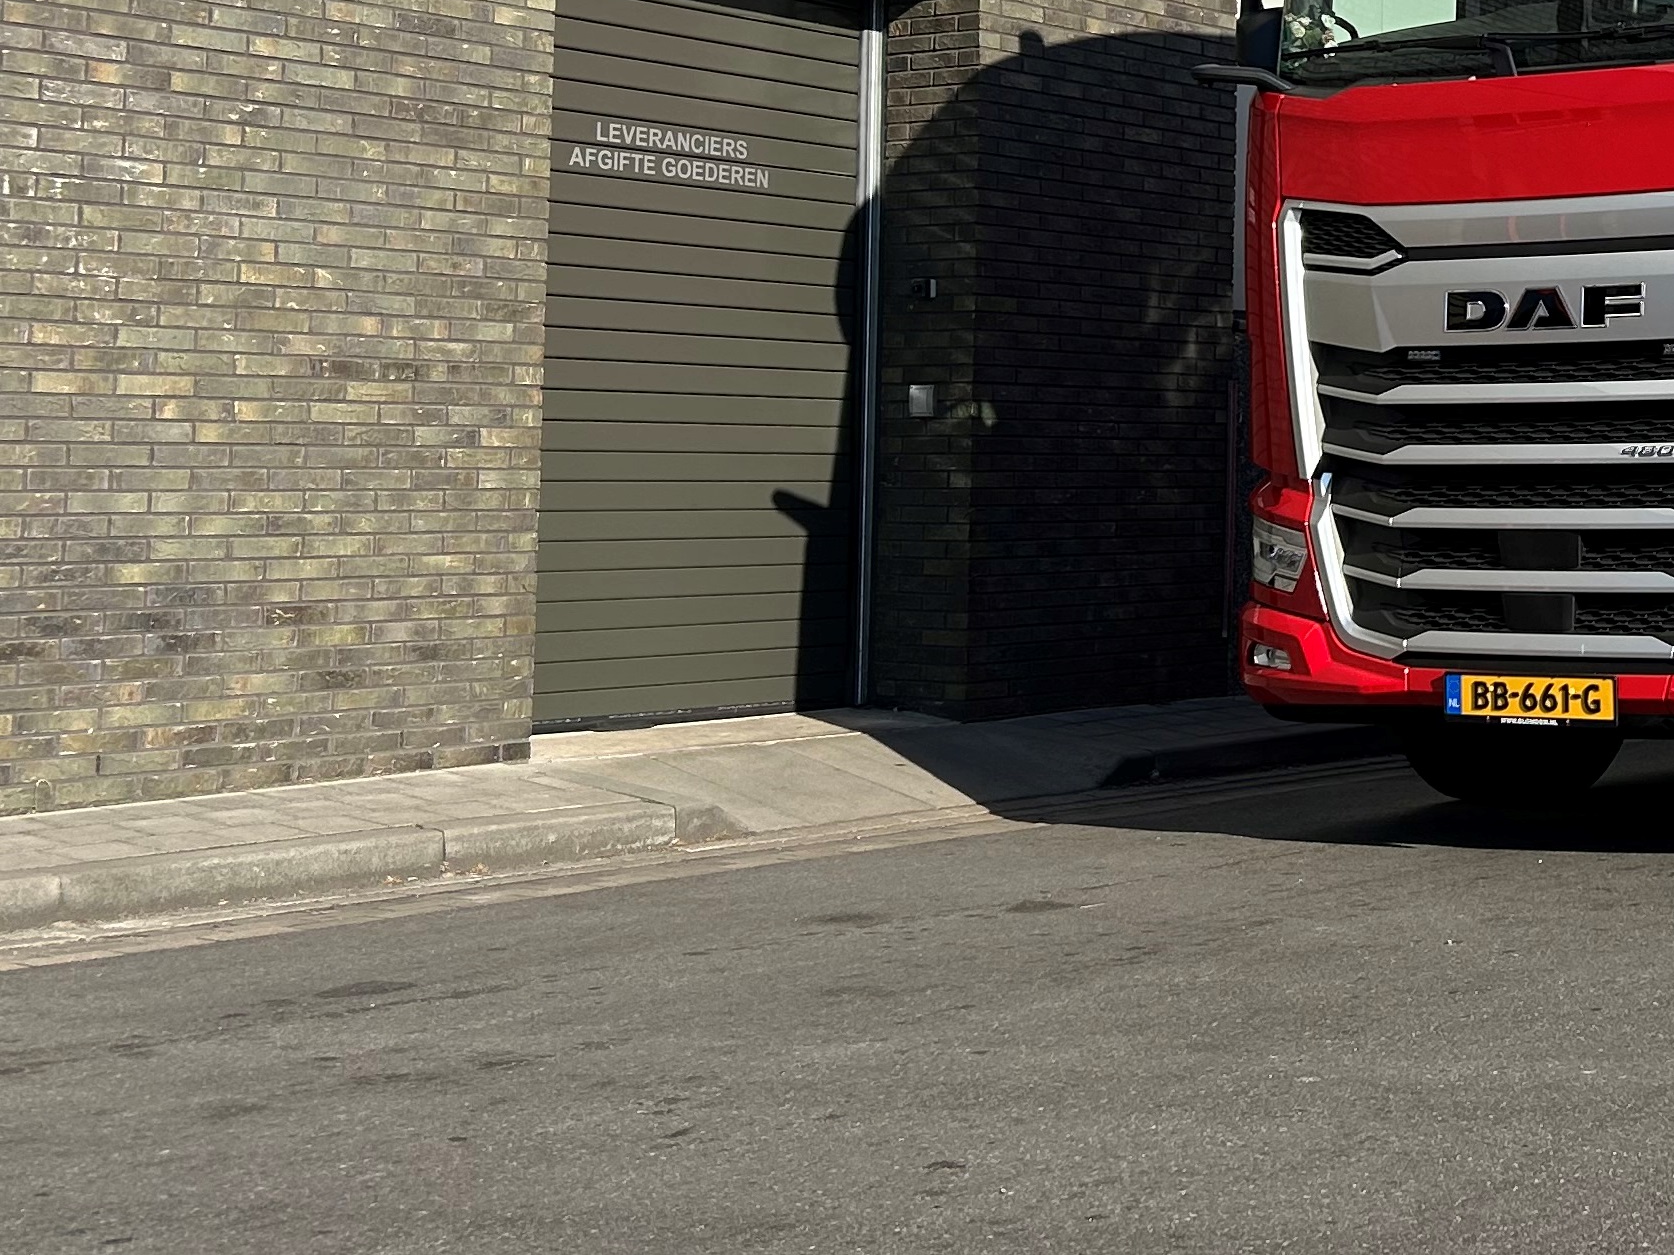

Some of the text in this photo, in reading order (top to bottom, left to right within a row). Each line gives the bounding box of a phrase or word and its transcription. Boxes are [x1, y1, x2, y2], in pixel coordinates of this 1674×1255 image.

[595, 121, 748, 160] LEVERANCIERS
[568, 146, 770, 189] AFGIFTE GOEDEREN
[1443, 281, 1647, 333] DAF
[1448, 680, 1602, 715] NL BB-661-G
